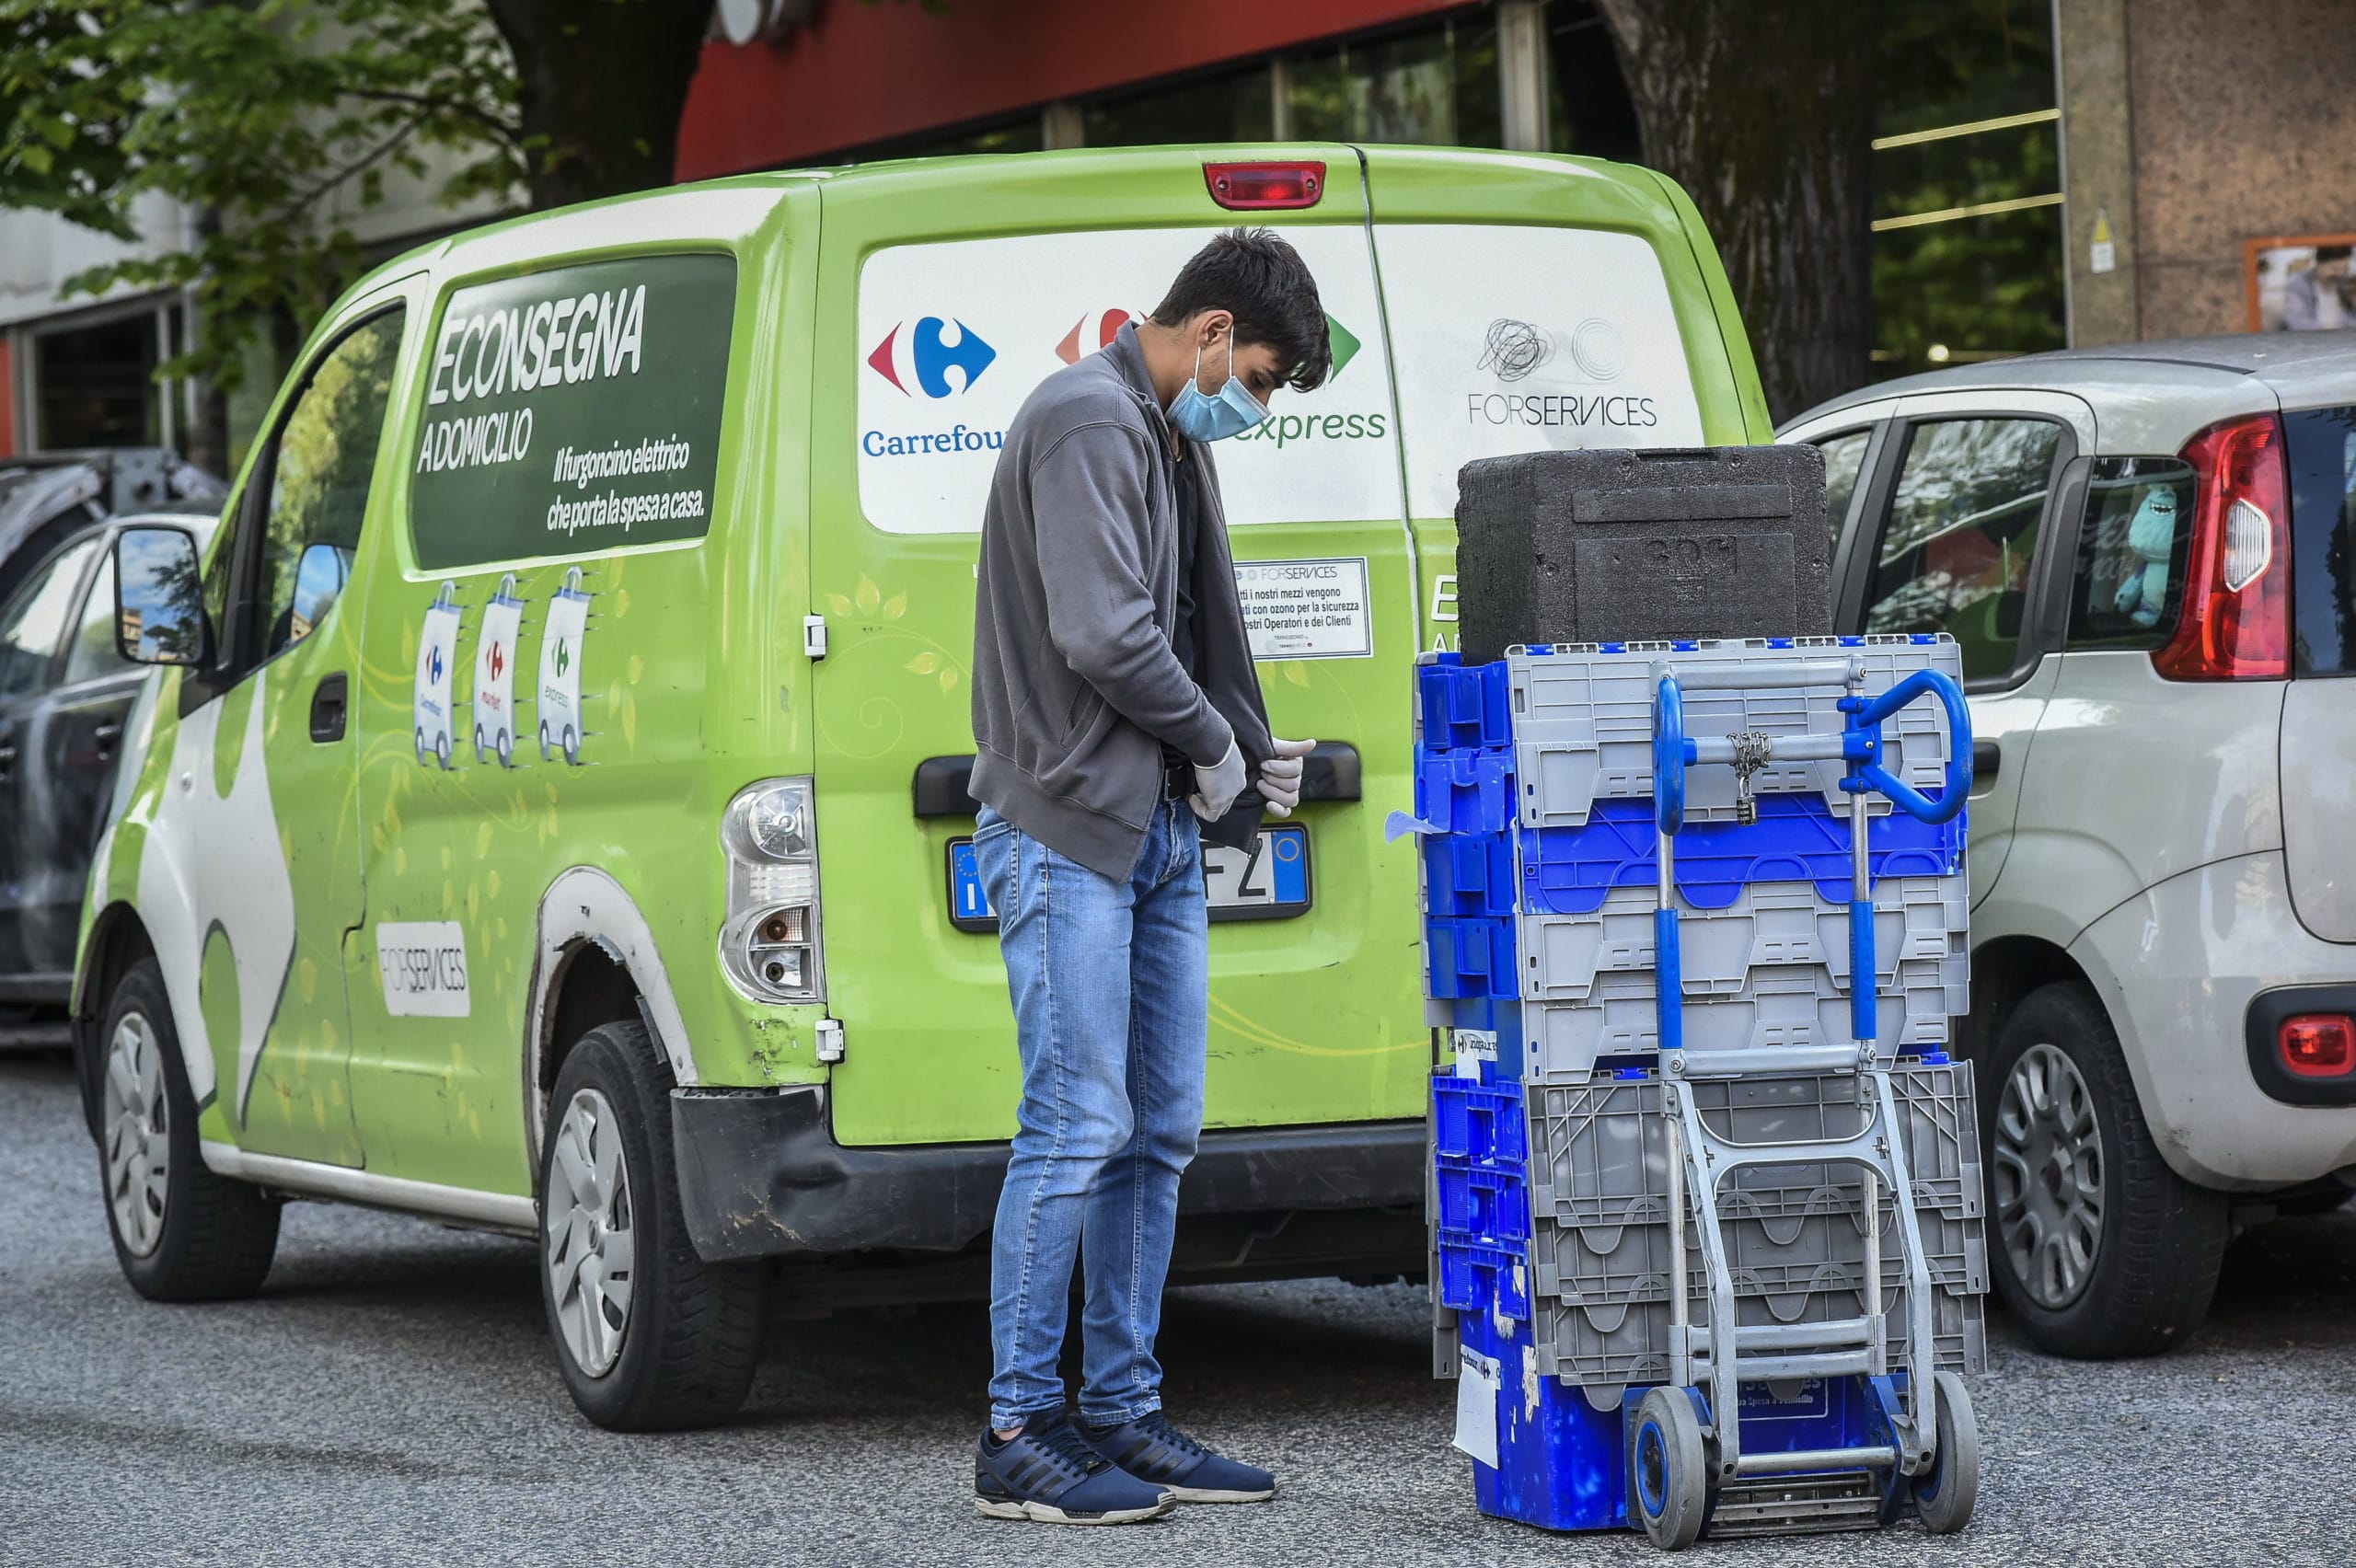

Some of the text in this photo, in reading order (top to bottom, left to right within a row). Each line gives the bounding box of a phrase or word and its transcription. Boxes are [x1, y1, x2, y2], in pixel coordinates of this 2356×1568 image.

[429, 284, 646, 405] ECONSEGNA
[1468, 394, 1657, 426] FORSERVICES
[416, 408, 533, 474] A DOMICILIO
[863, 424, 1009, 457] Carrefou
[553, 432, 689, 490] Il furgoncino elettrico
[547, 489, 704, 537] che porta la spesa a casa.
[1261, 566, 1338, 581] FORSERVICES
[1253, 605, 1268, 615] con
[1270, 605, 1295, 615] ozono
[1297, 604, 1311, 616] per
[1311, 601, 1320, 613] la
[1322, 601, 1359, 612] sicurezza
[1254, 587, 1278, 600] nostri
[1280, 586, 1303, 599] mezzi
[1305, 588, 1341, 600] vengono
[1244, 618, 1262, 629] ostri
[1264, 617, 1302, 631] Operatori
[1311, 616, 1323, 628] dei
[1325, 615, 1352, 627] Clienti
